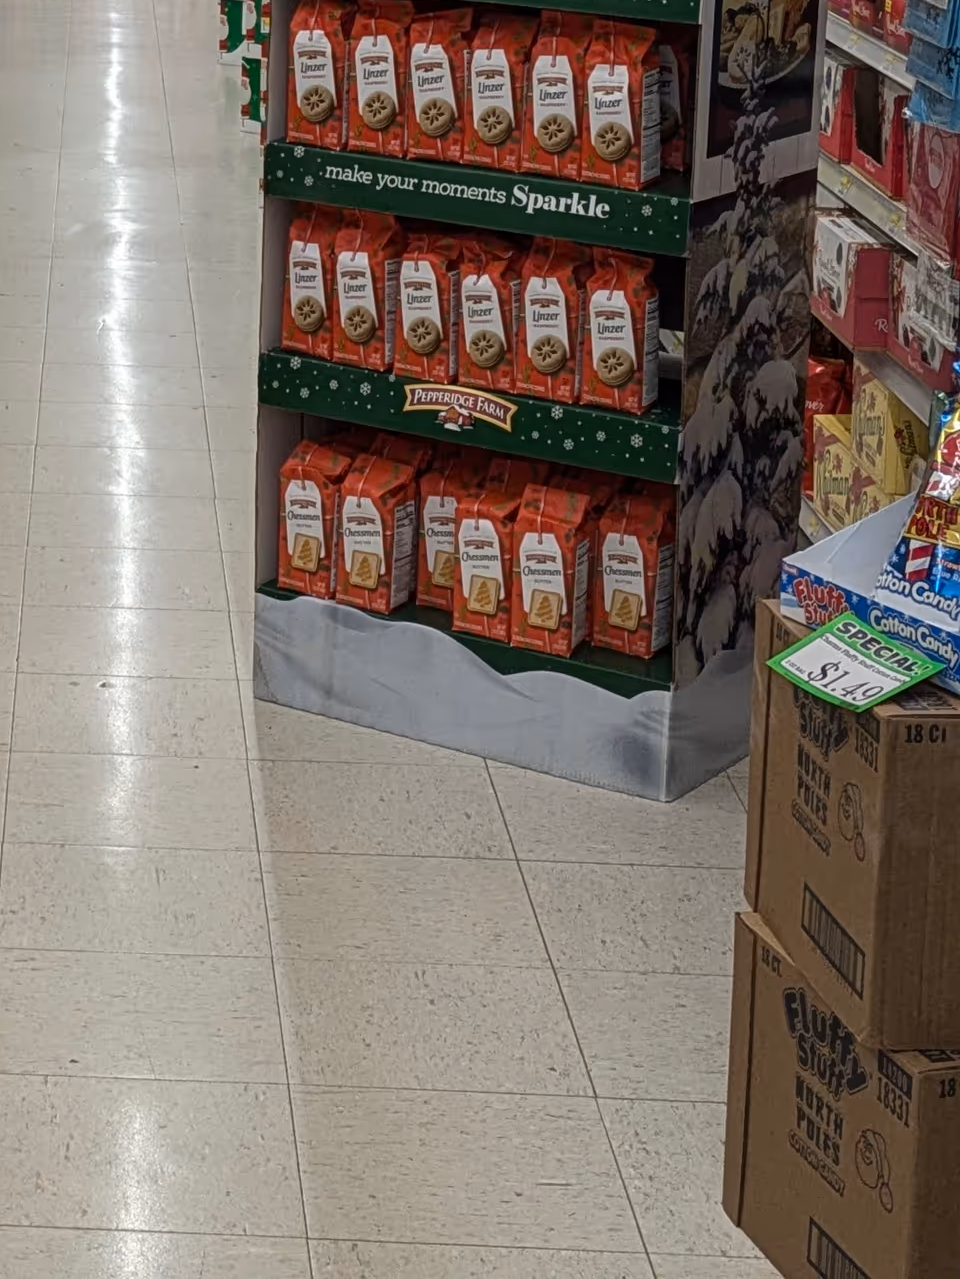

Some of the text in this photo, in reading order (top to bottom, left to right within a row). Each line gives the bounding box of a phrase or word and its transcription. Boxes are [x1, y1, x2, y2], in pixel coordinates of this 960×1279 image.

[300, 61, 328, 74] Linzer
[363, 67, 390, 80] Linzer
[417, 74, 445, 88] Linzer
[478, 82, 505, 94] Linzer
[539, 88, 568, 102] Linzer
[594, 96, 623, 110] Linzer
[325, 165, 611, 219] make your moments Sparkle
[294, 272, 318, 284] Linzer
[344, 282, 368, 294] Linzer
[406, 293, 434, 305] Linzer
[468, 306, 494, 319] Linzer
[532, 310, 561, 323] Linzer
[597, 322, 627, 335] Linzer
[413, 388, 505, 419] PEPPERIDGE FARM
[287, 510, 321, 522] Chessmen
[344, 527, 381, 538] Chessmen
[462, 552, 499, 564] Chessmen
[522, 565, 562, 577] Chessmen
[604, 566, 642, 578] Chessmen
[869, 609, 958, 669] Cotton Candy
[834, 620, 931, 677] SPECIAL!
[807, 659, 886, 703] $1.49
[904, 723, 924, 744] 18
[938, 1077, 957, 1099] 18
[796, 1074, 844, 1140] NORTH
[877, 1075, 910, 1129] 18331
